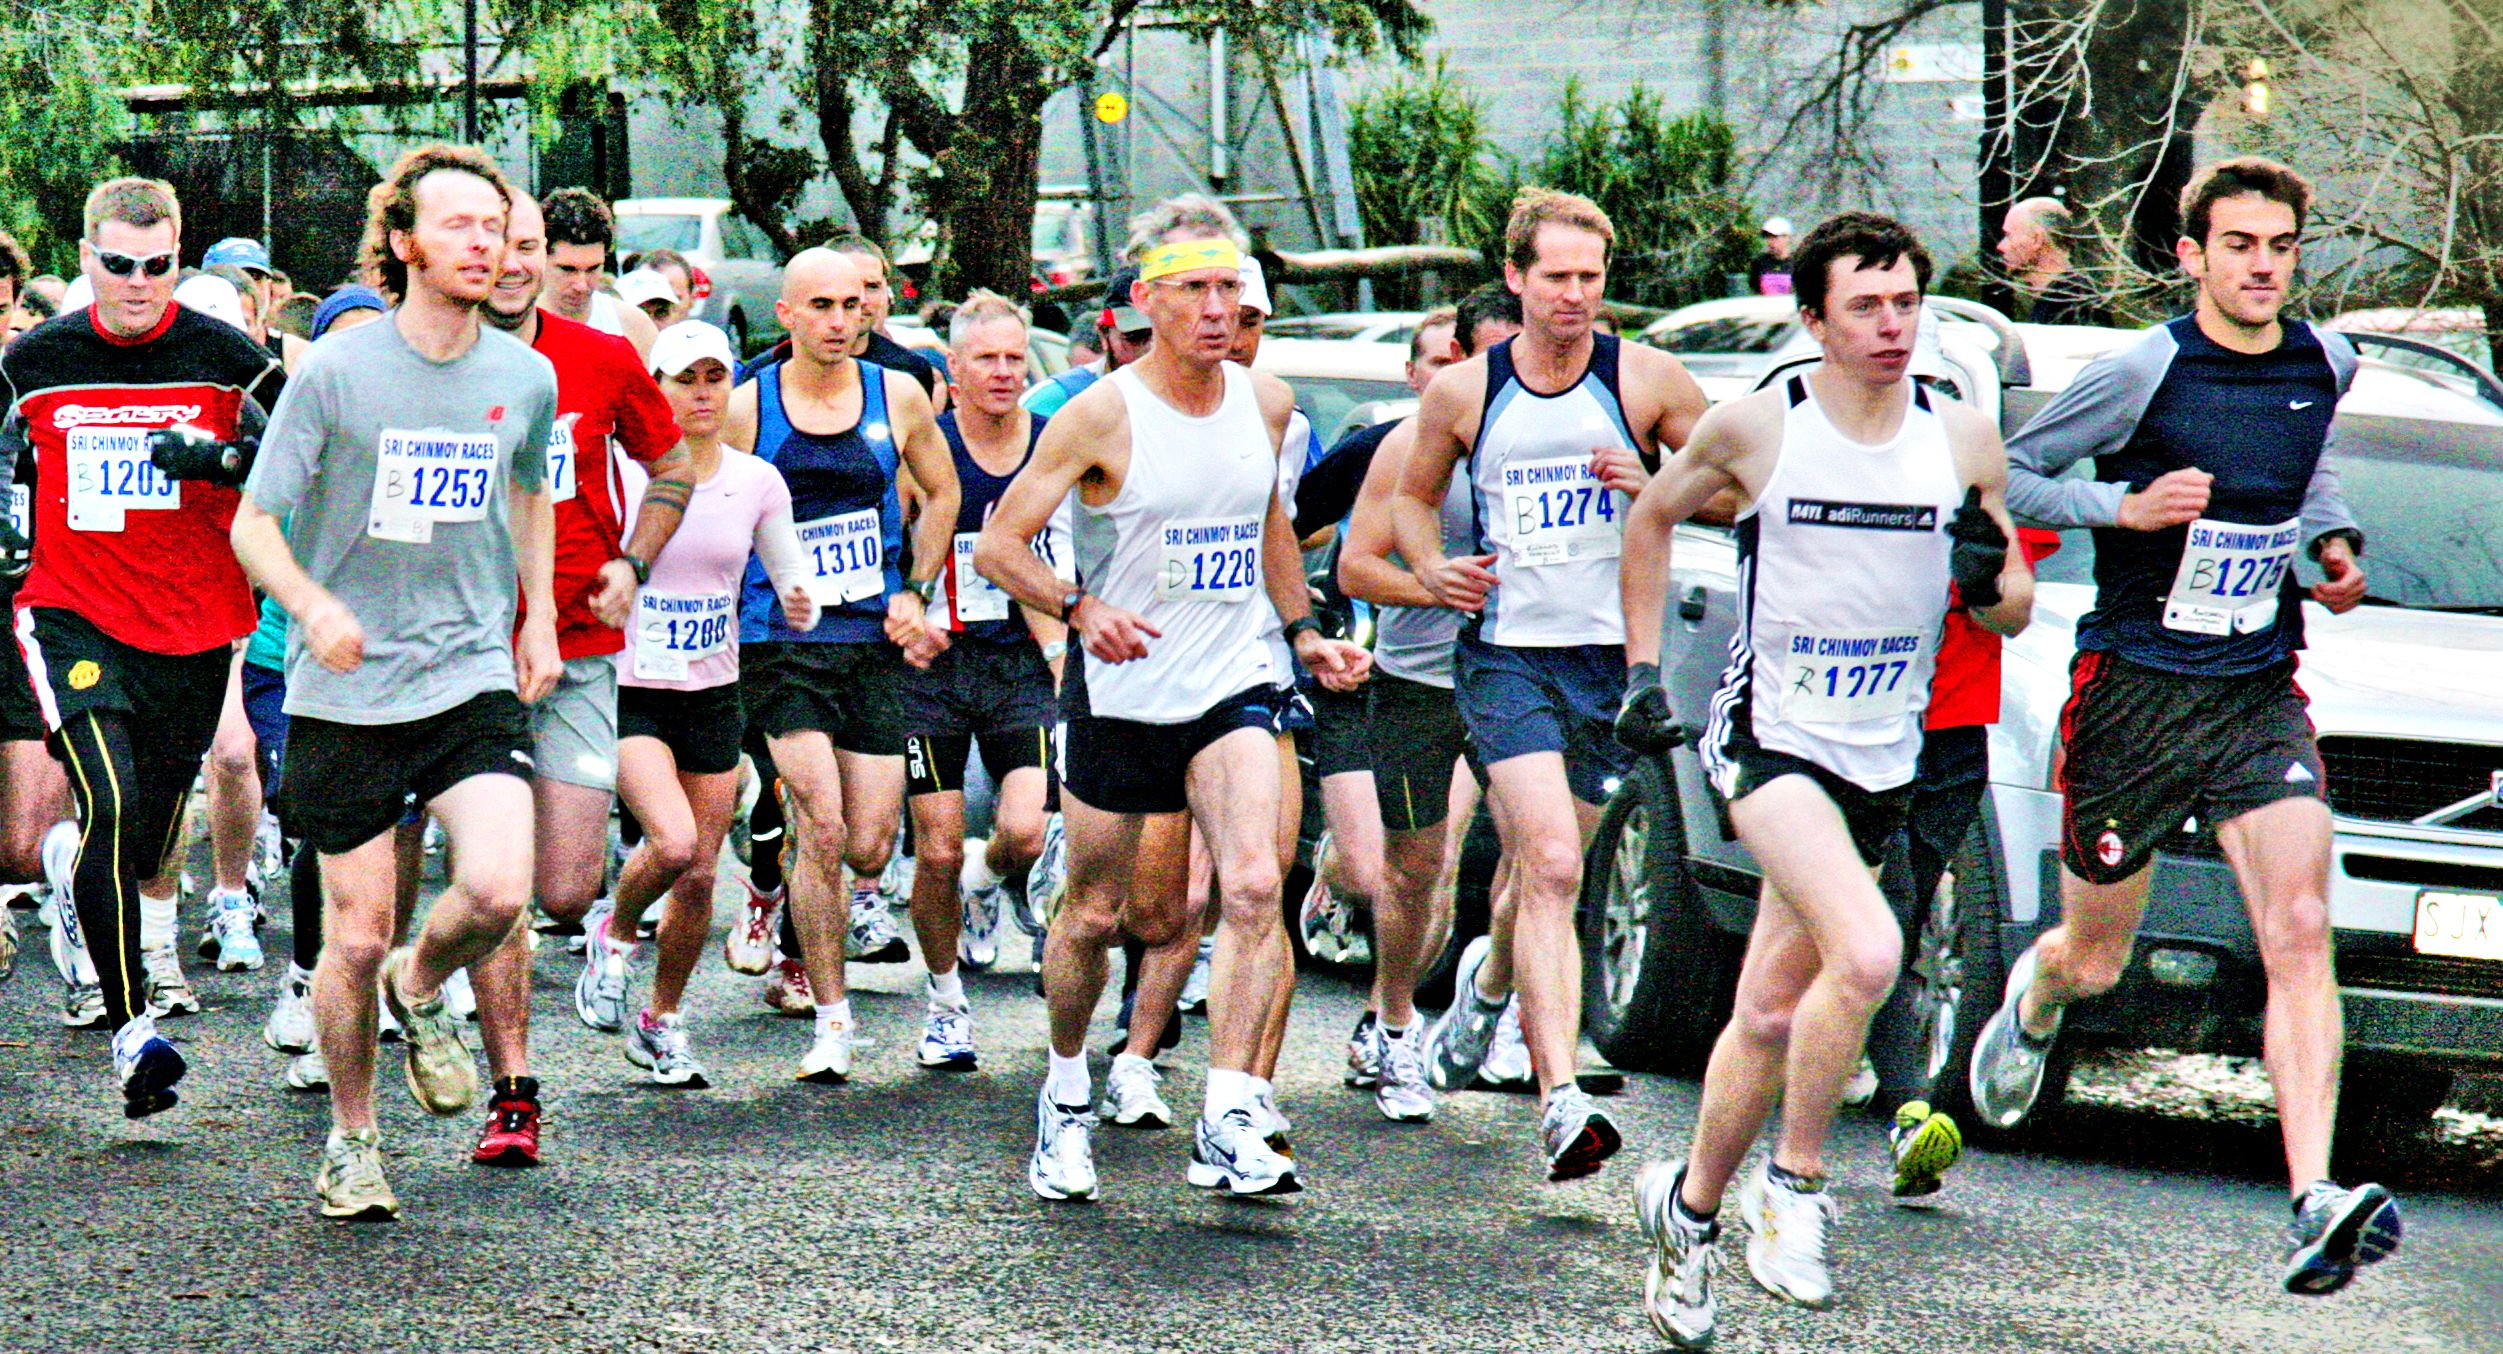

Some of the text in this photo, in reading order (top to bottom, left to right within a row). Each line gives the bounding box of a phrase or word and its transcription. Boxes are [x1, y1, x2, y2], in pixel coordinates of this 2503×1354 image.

[71, 435, 87, 450] SRI
[92, 435, 139, 451] CHINMOY
[384, 438, 495, 460] SRI CHINMOY RACES
[386, 470, 405, 499] B
[409, 466, 488, 508] 1253
[1506, 469, 1524, 486] SRI
[1527, 464, 1577, 485] CHINMOY
[1516, 496, 1536, 535] B
[1538, 486, 1614, 529] 1274
[1828, 507, 1914, 527] adiRunners
[802, 522, 844, 542] CHINMOY
[847, 516, 877, 534] RACES
[1165, 522, 1259, 545] SRI CHINMOY RACES
[2191, 527, 2297, 551] SRI CHINMOY RACES
[812, 536, 877, 577] 1310
[958, 540, 973, 553] SRI
[1168, 559, 1187, 589] D
[1191, 547, 1255, 590] 1228
[2190, 558, 2216, 590] B
[2209, 552, 2291, 597] 1275
[643, 595, 731, 613] SRI CHINMOY RACES
[1792, 635, 1919, 657] SRI CHINMOY RACES
